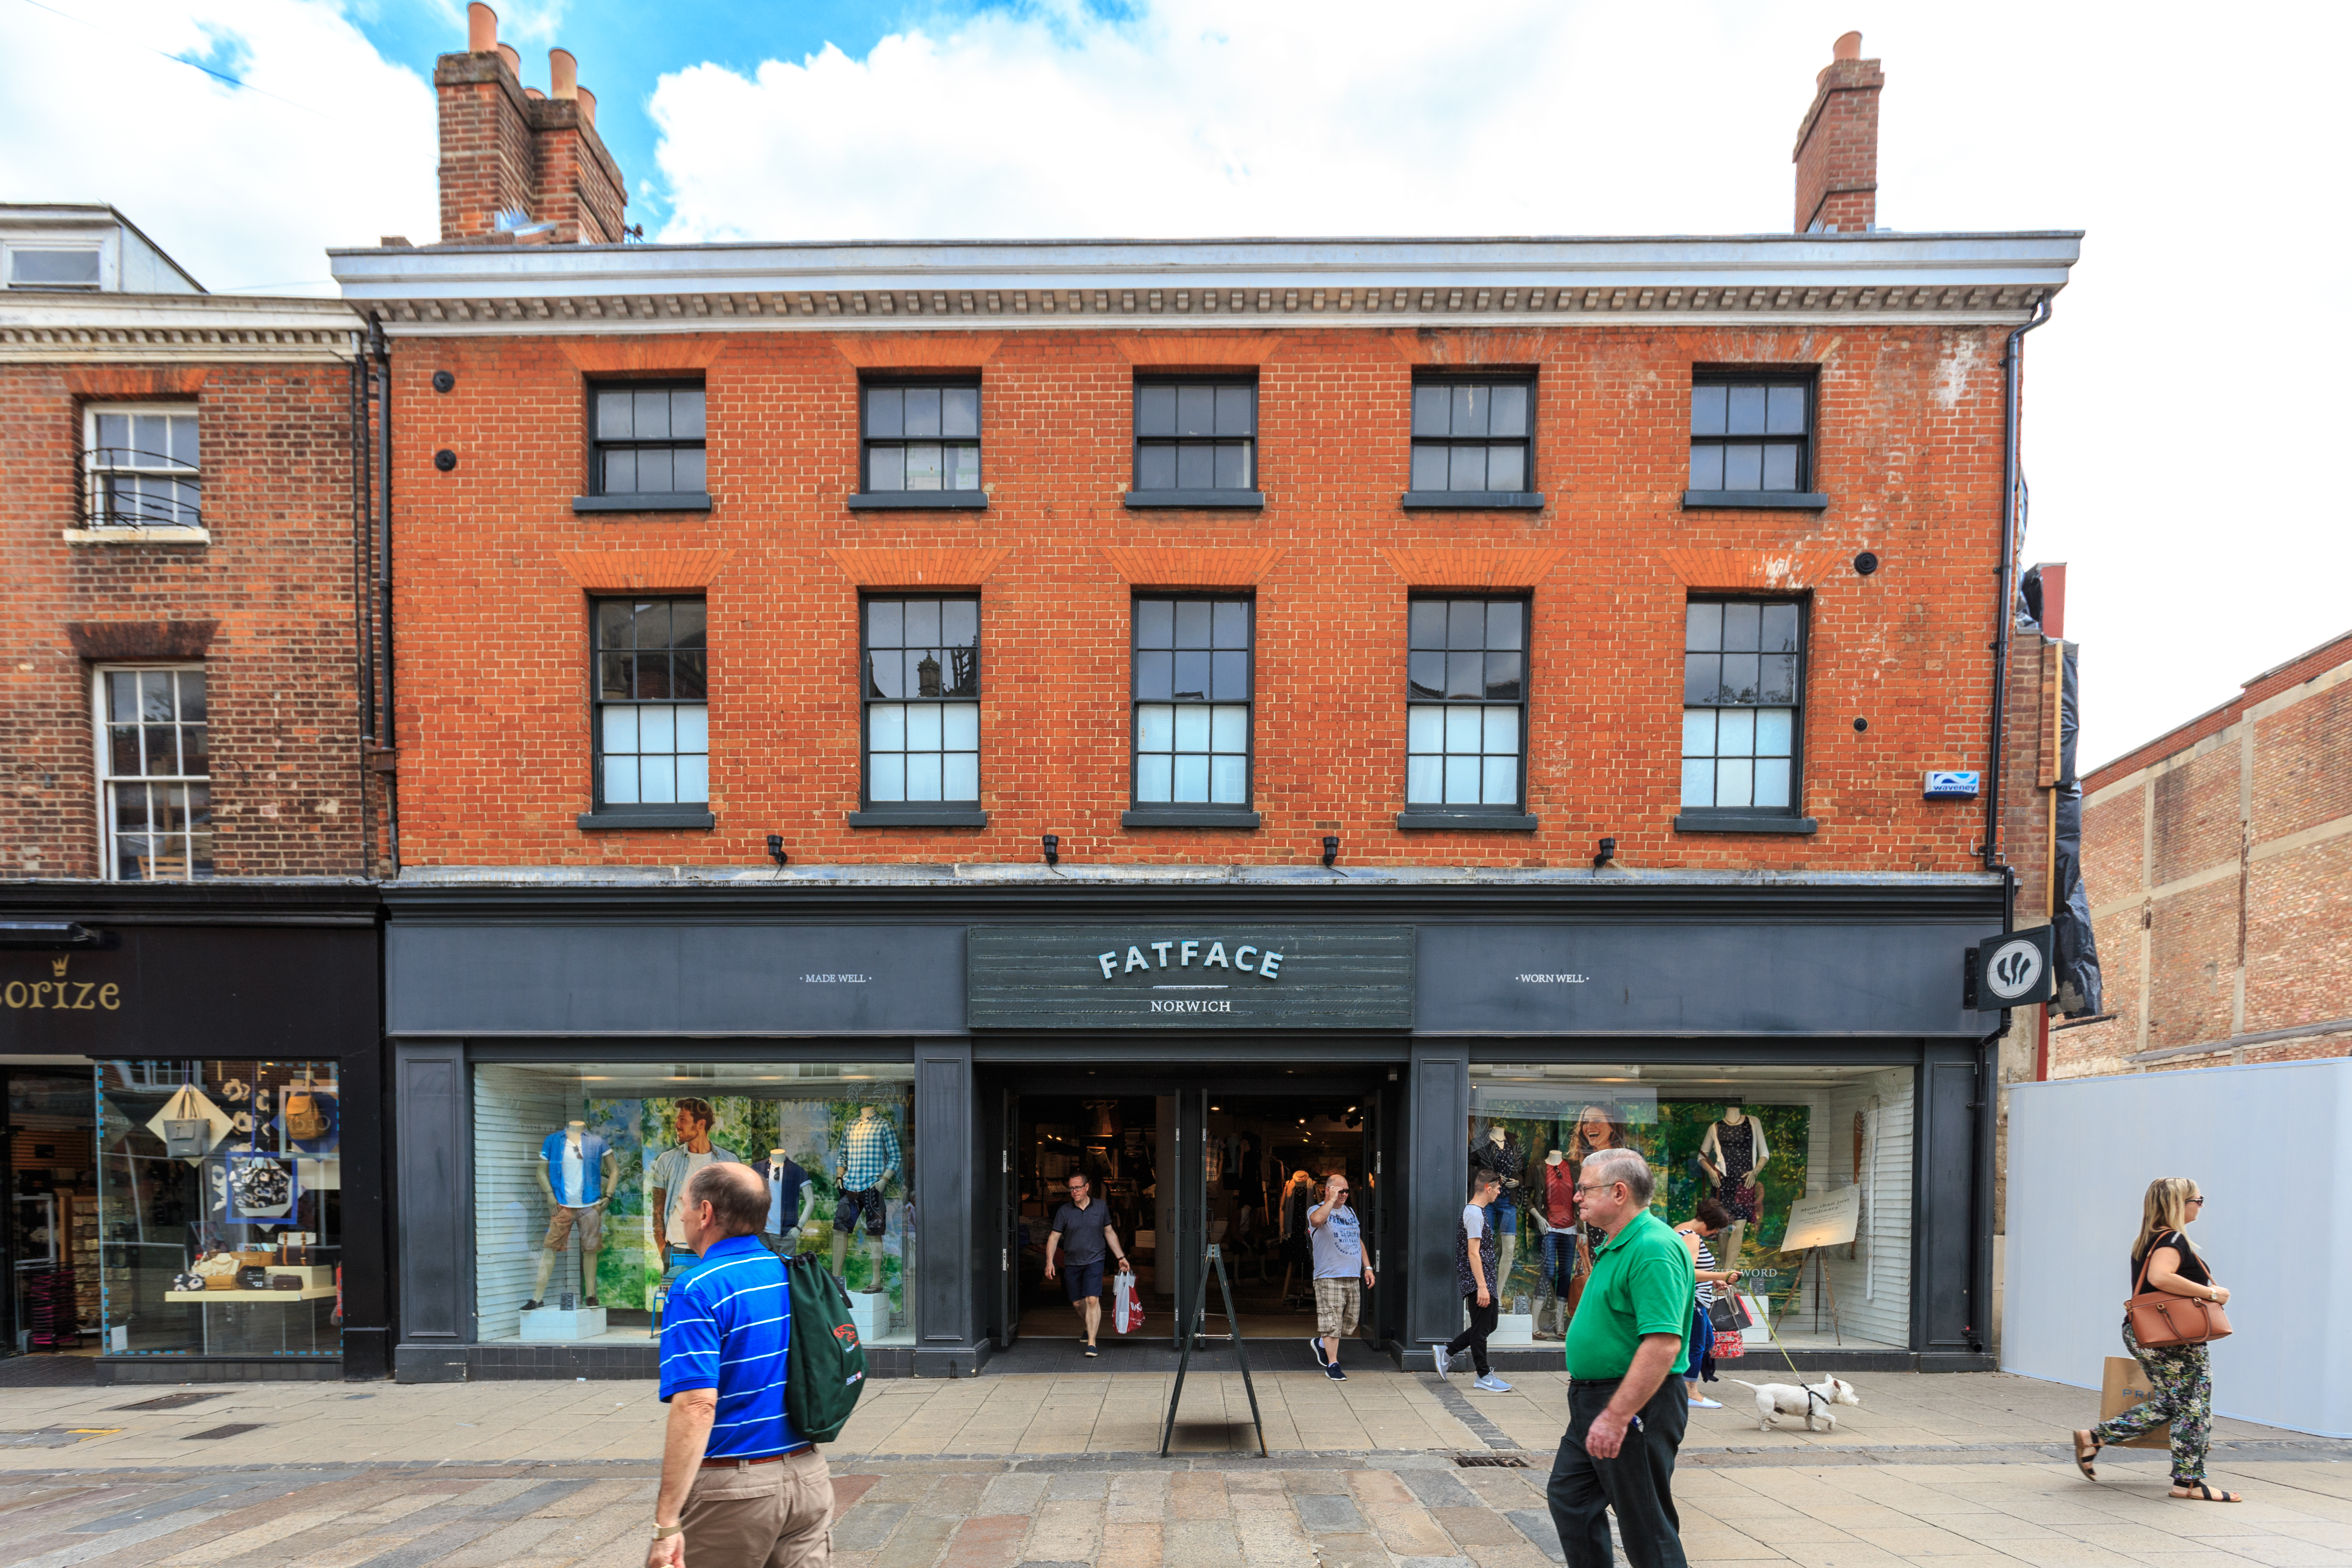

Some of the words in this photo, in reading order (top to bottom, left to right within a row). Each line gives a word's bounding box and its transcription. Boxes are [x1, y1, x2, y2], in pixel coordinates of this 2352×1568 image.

[1098, 940, 1284, 980] FATFACE
[805, 974, 836, 983] MADE
[837, 974, 866, 983] WELL
[1520, 974, 1554, 983] WORN
[1555, 974, 1584, 983] WELL
[0, 981, 120, 1010] orize
[1150, 1001, 1232, 1012] NORWICH
[1334, 1242, 1348, 1255] GOLDEN
[1740, 1268, 1777, 1277] WORD
